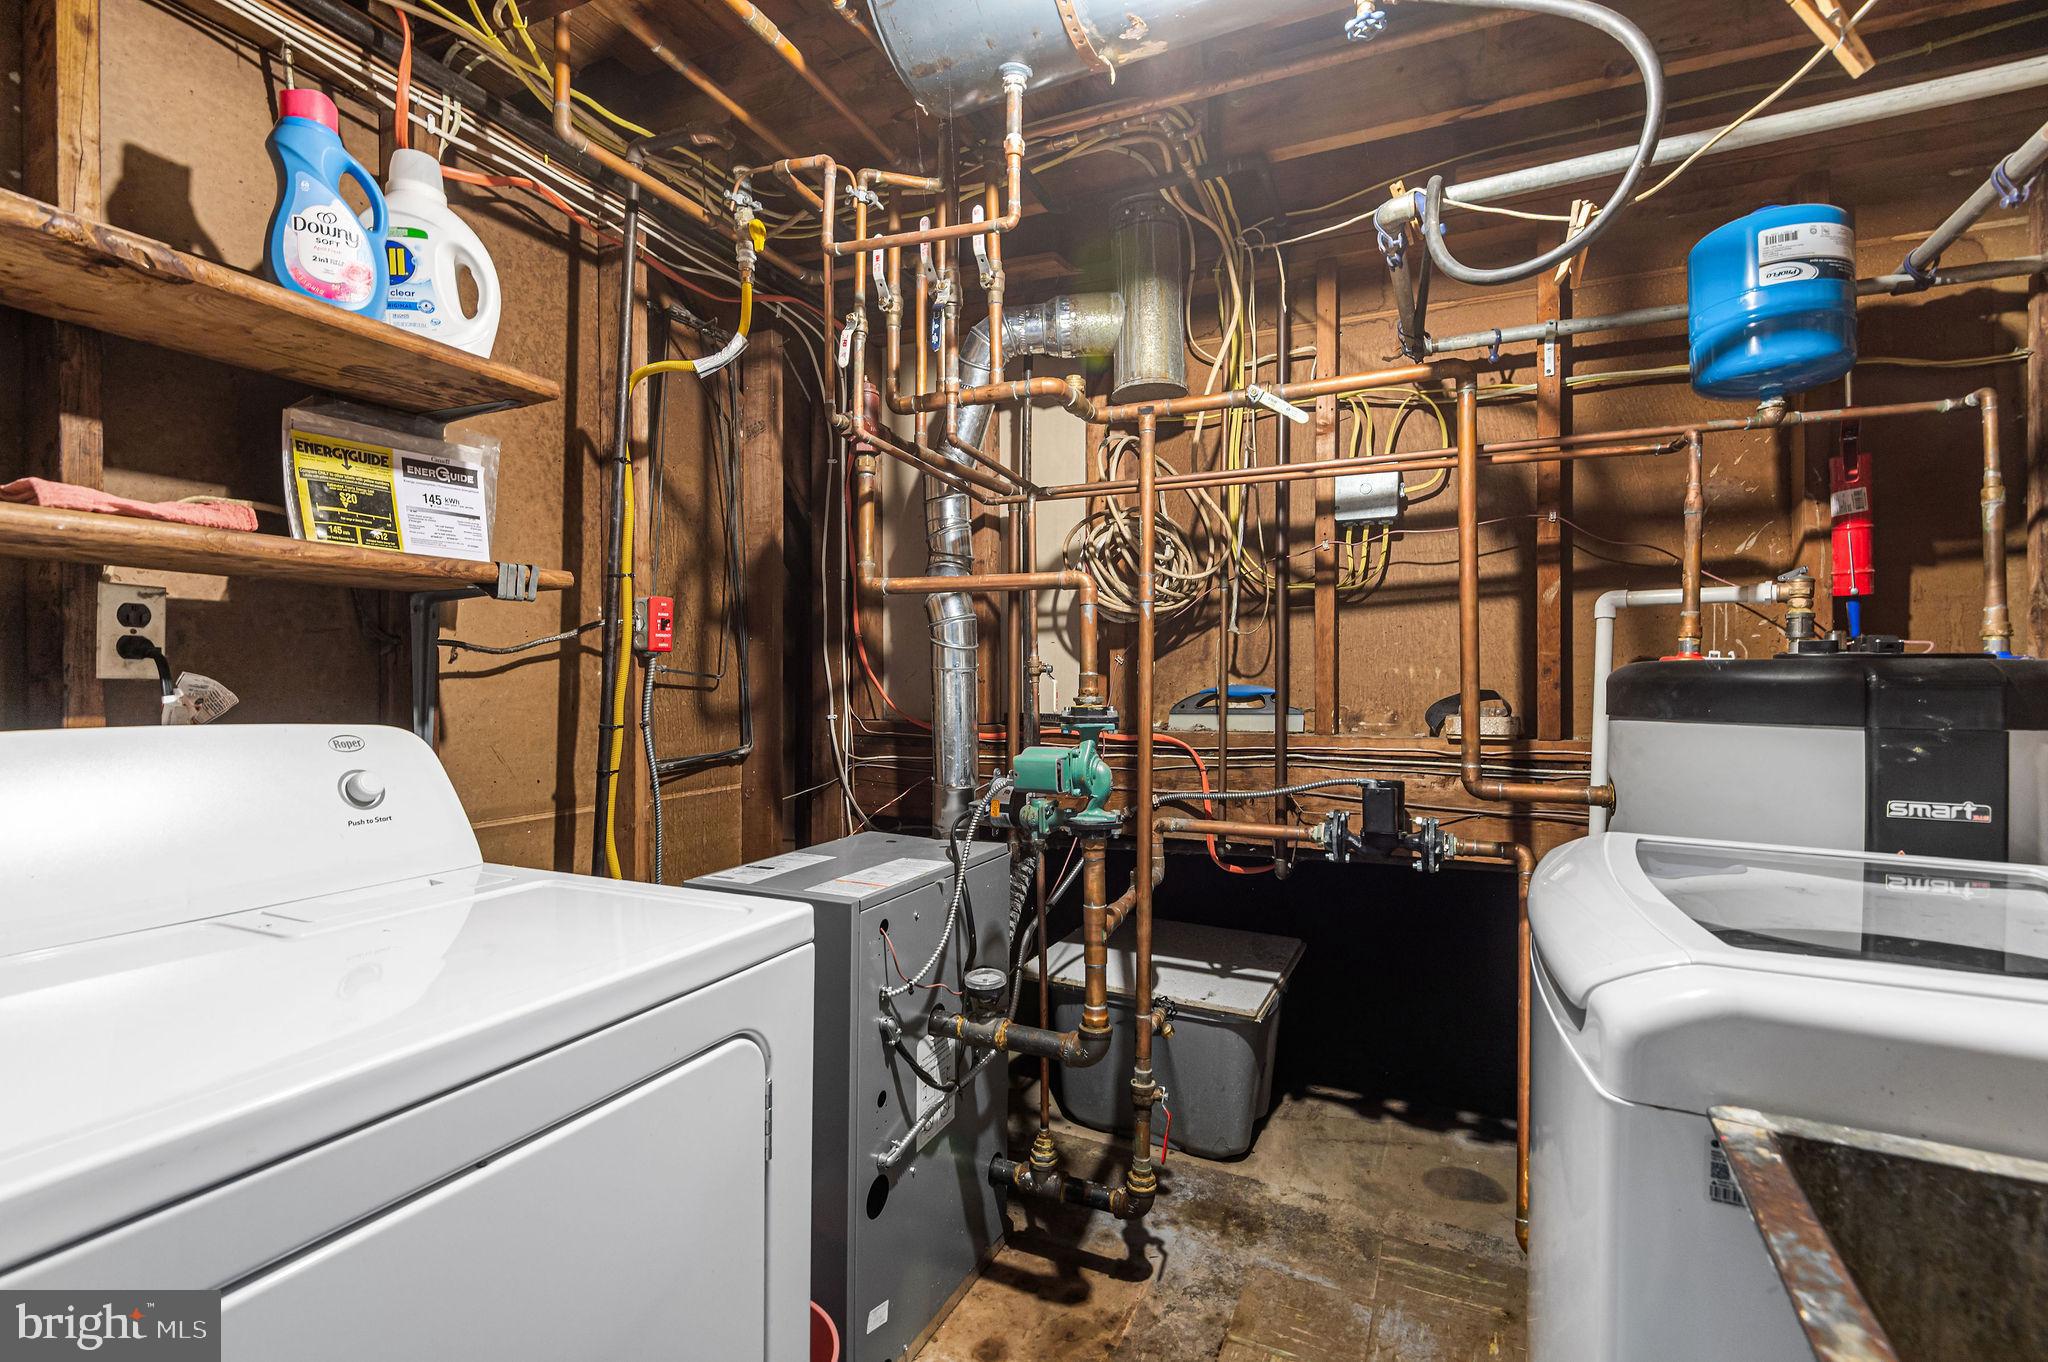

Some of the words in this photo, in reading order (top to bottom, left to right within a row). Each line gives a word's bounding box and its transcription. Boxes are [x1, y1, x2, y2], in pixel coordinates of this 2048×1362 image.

[293, 216, 359, 248] Downy
[315, 237, 340, 247] SOFT
[390, 288, 415, 297] clear
[295, 439, 389, 468] ENERGYGUIDE
[406, 465, 475, 483] ENERGUIDE
[339, 491, 357, 504] $20
[422, 493, 442, 506] 145
[444, 497, 460, 505] kWh
[328, 525, 343, 535] 145
[333, 739, 361, 749] Roper
[1889, 803, 1977, 820] smart
[348, 818, 365, 827] Push
[374, 815, 392, 823] Start
